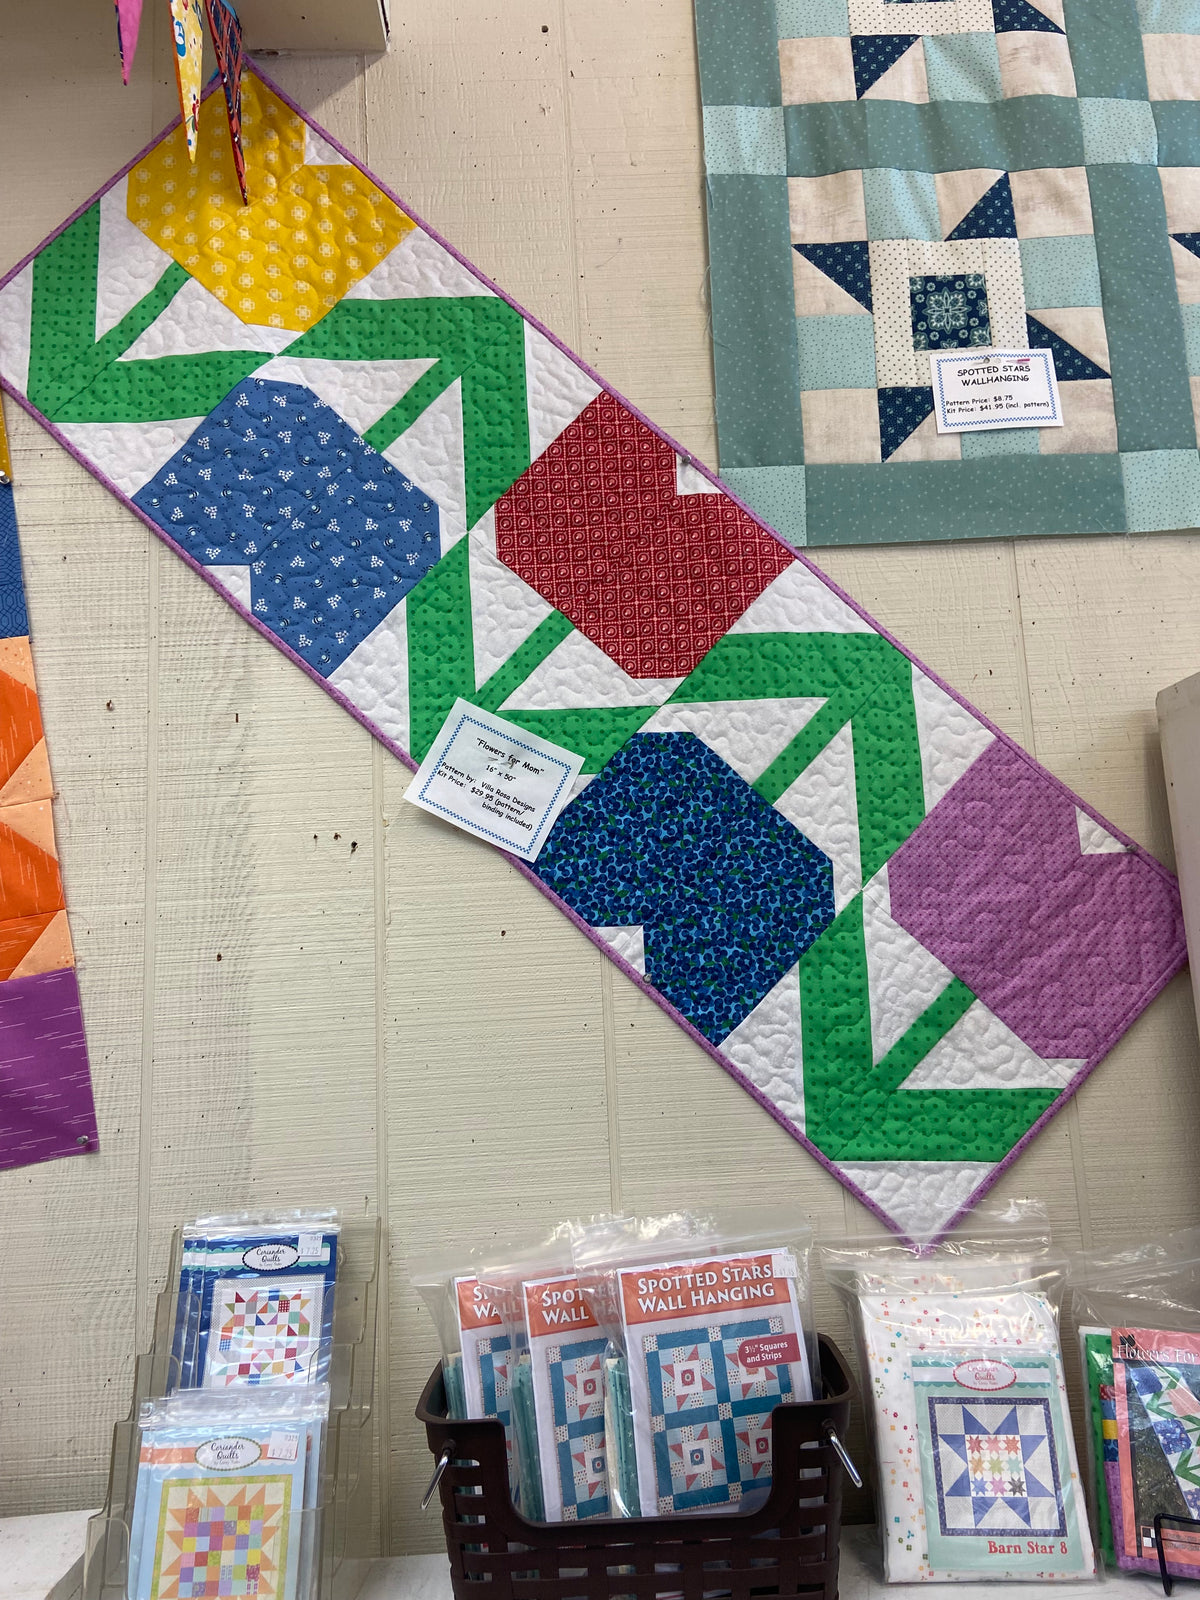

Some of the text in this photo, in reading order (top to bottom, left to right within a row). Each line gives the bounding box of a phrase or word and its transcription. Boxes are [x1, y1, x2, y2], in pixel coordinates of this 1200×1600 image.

[957, 365, 1031, 377] SPOTTED STARS
[961, 375, 1030, 387] WALLHANGING
[945, 395, 1013, 407] Pattern Price: $8.75
[979, 404, 1004, 412] $41.95
[1005, 402, 1021, 410] (incl.
[1023, 401, 1050, 410] pattern)
[476, 738, 545, 776] "Flowers for Mom"
[486, 764, 498, 774] 16"
[503, 773, 517, 783] 50"
[437, 769, 525, 817] Kit Price: $29.95 (pattern/
[441, 761, 536, 814] Pattern by: Villa Rosa Designs
[481, 802, 534, 832] binding included)
[256, 1247, 286, 1256] Coriander
[261, 1254, 281, 1263] Quilts
[638, 1263, 773, 1295] SPOTTED STARS
[638, 1295, 687, 1314] WALL
[691, 1282, 775, 1308] HANGING
[541, 1306, 590, 1327] WALL
[759, 1341, 789, 1353] Squares
[1117, 1343, 1170, 1361] Flowers
[746, 1351, 783, 1364] and Strips
[210, 1441, 245, 1452] Coriander
[216, 1449, 240, 1460] Quilts
[987, 1540, 1068, 1554] Barn Star 8
